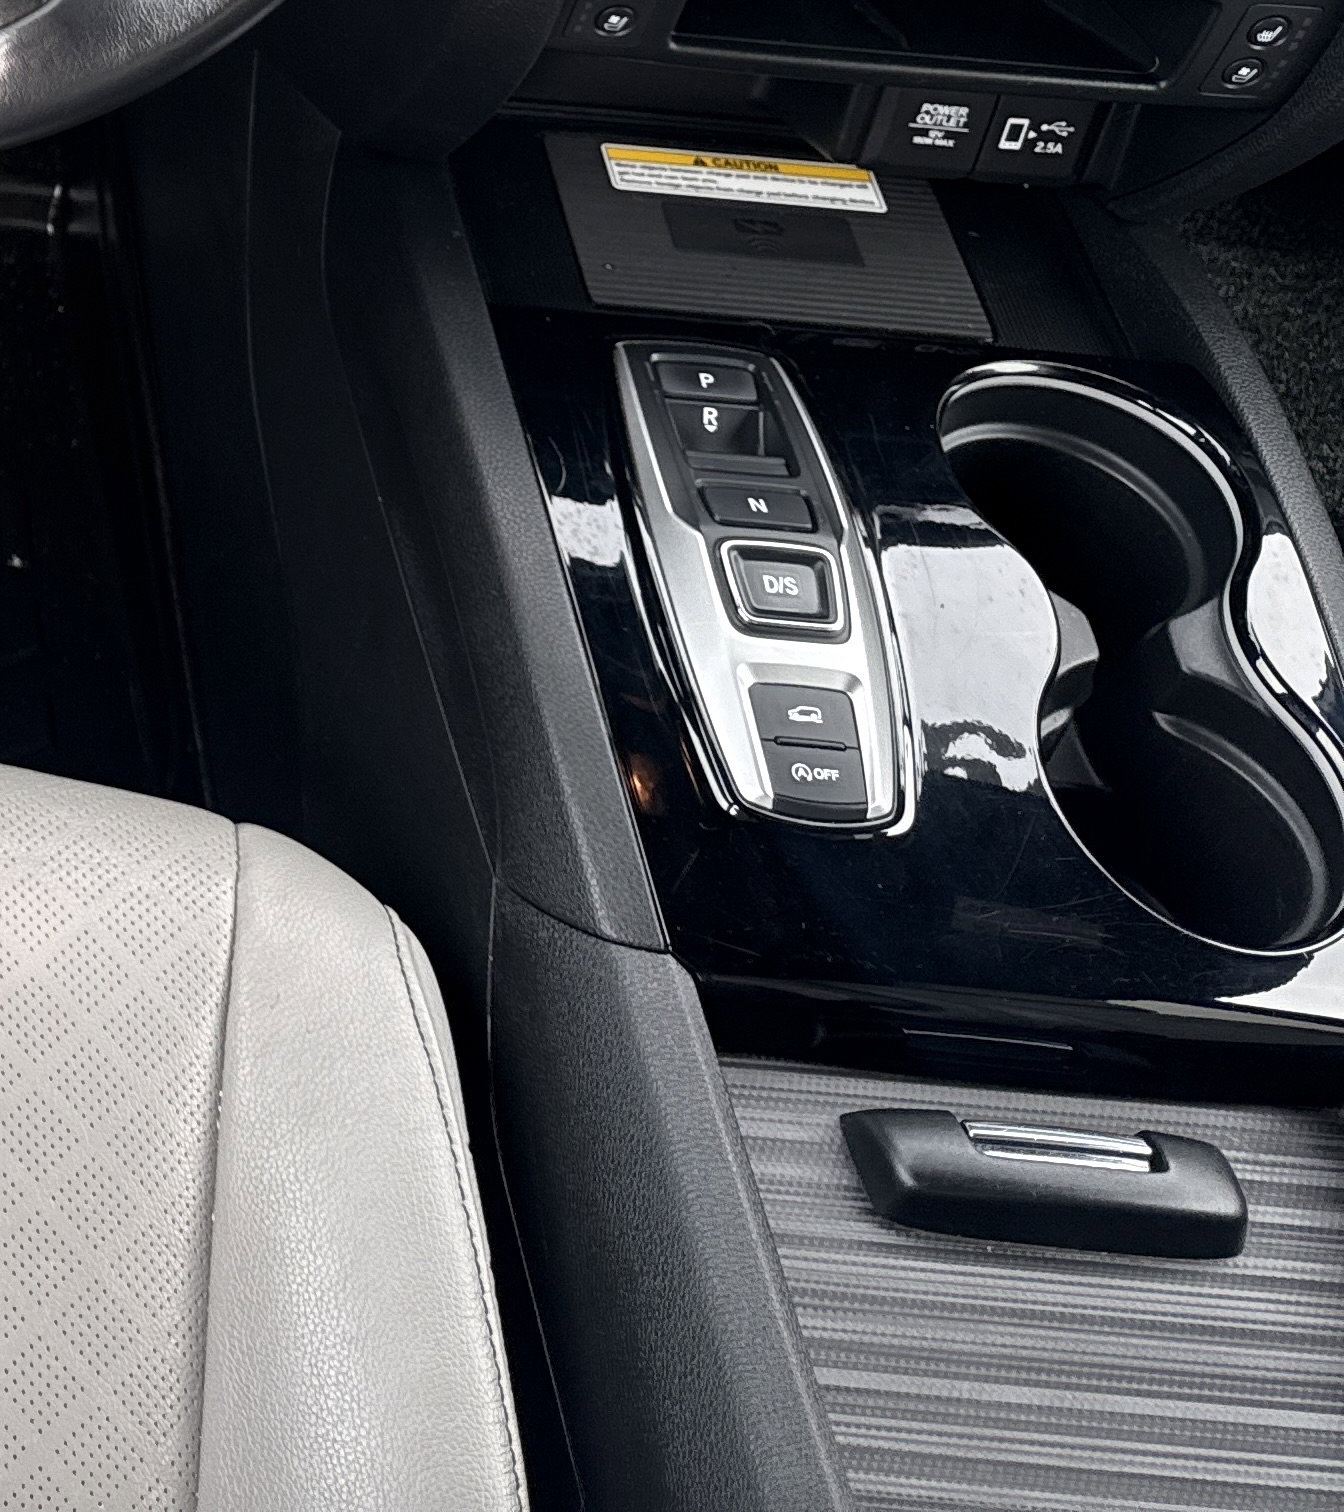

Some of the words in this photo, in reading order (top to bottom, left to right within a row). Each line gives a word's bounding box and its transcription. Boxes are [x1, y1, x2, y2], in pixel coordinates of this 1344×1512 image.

[920, 102, 970, 117] POWER
[915, 112, 968, 127] OUTLET
[1033, 140, 1063, 155] 2.5A
[711, 156, 779, 173] CAUTION
[698, 372, 715, 388] P
[702, 407, 718, 425] R
[747, 497, 769, 514] N
[762, 573, 800, 596] D/S
[813, 767, 840, 782] OFF
